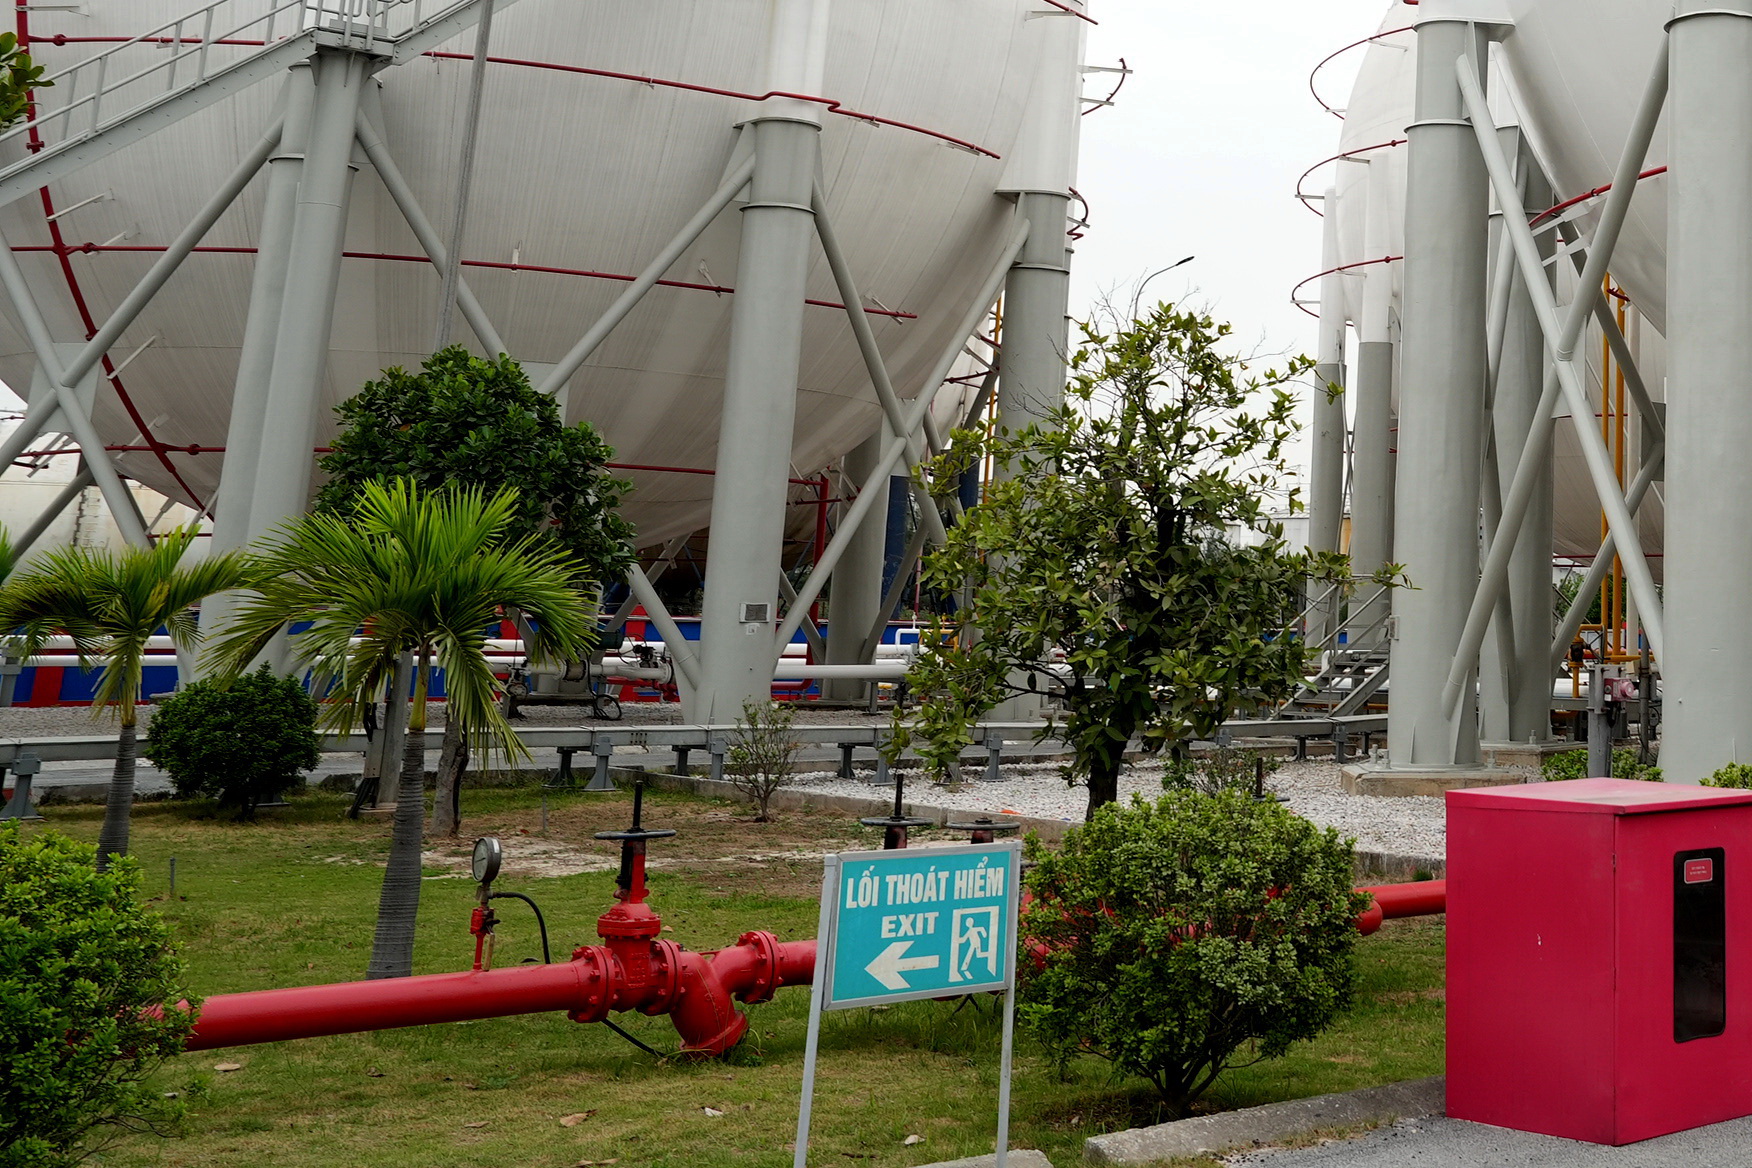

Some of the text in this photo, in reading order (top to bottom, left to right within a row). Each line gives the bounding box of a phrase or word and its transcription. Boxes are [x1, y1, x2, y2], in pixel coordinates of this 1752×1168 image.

[845, 856, 1005, 910] LỐI THOÁT HIỂM
[880, 911, 940, 939] EXIT
